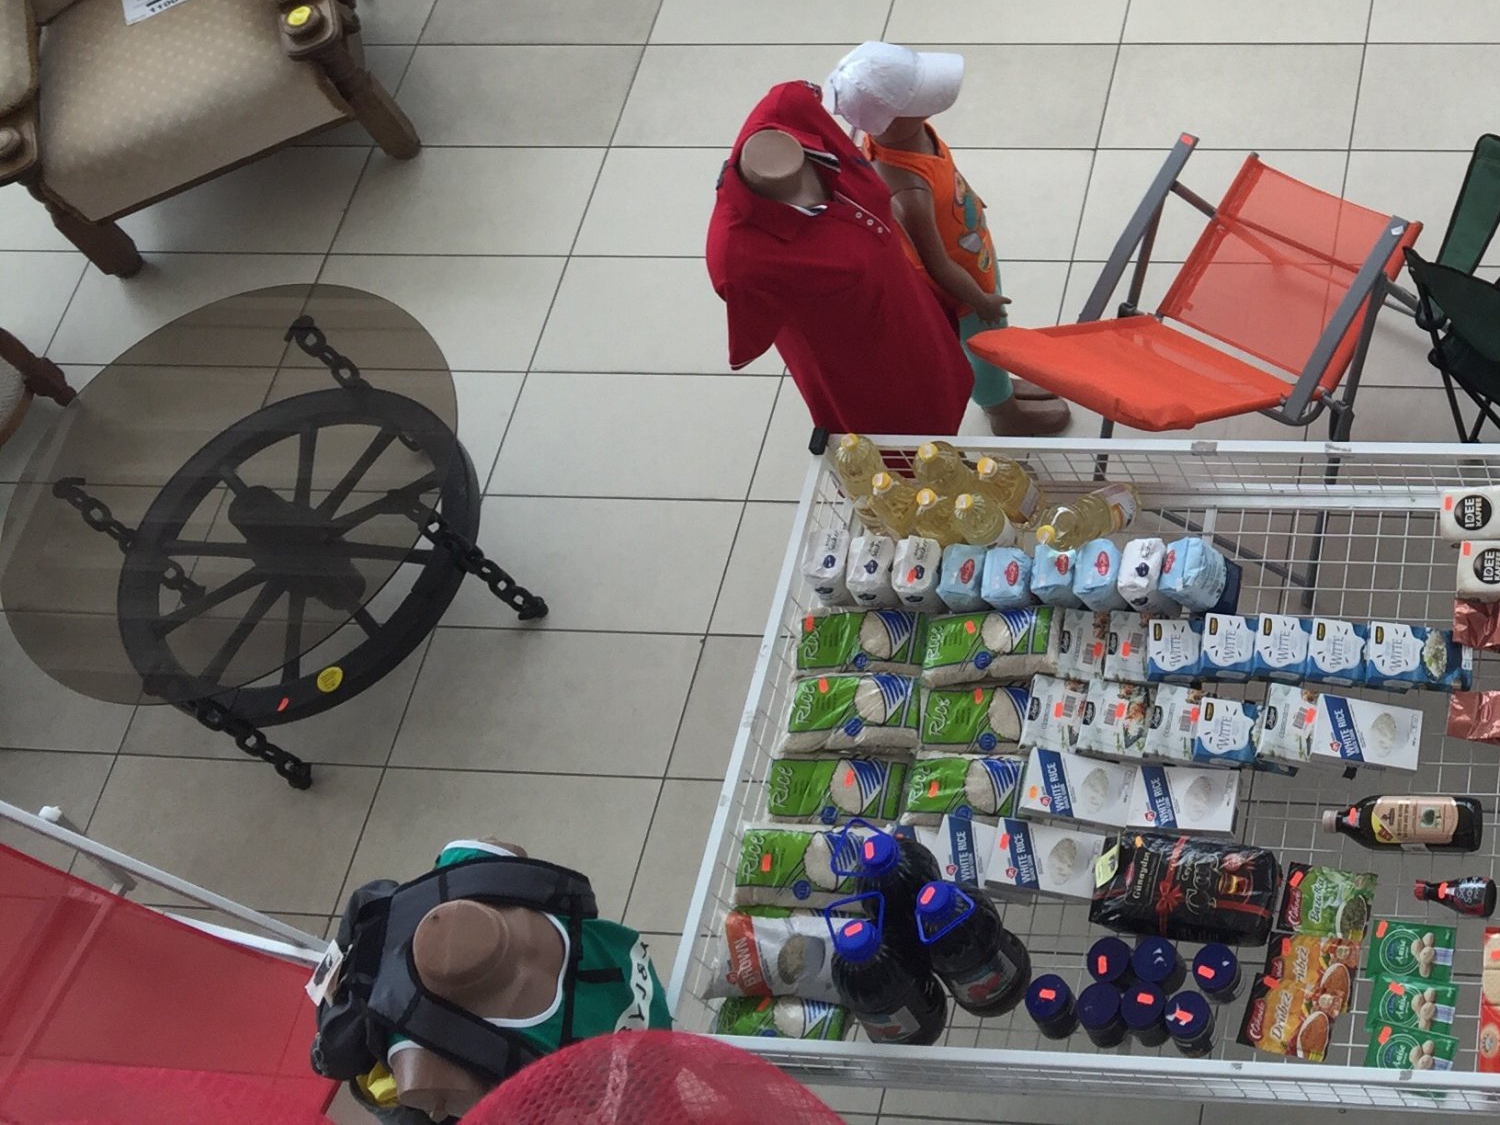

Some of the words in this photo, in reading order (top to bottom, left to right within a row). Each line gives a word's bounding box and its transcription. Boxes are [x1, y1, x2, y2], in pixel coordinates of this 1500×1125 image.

[1464, 497, 1475, 528] IDEE
[1474, 497, 1483, 527] KAFFEE
[1483, 550, 1496, 582] IDEE
[1169, 633, 1183, 668] WITTE
[1222, 629, 1237, 663] WITTE
[1276, 630, 1292, 664] WITTE
[1330, 634, 1345, 670] WITTE
[1389, 638, 1405, 673] WITTE
[796, 683, 816, 724] Rice
[927, 697, 951, 737] Rice
[1334, 708, 1345, 728] RICE
[1217, 715, 1234, 754] WITTE
[1339, 727, 1355, 758] WHITE
[770, 765, 795, 808] Rice
[908, 765, 931, 805] Rice
[1047, 762, 1058, 783] RICE
[1150, 777, 1162, 796] RICE
[1050, 782, 1067, 813] WHITE
[1153, 794, 1170, 825] WHITE
[741, 835, 765, 877] Rice
[956, 831, 967, 853] RICE
[1015, 832, 1025, 853] RICE
[960, 852, 971, 883] WHITE
[1018, 852, 1032, 883] WHITE
[1309, 876, 1325, 924] Bazalka
[734, 938, 757, 987] BROWN
[1296, 945, 1310, 982] růbež
